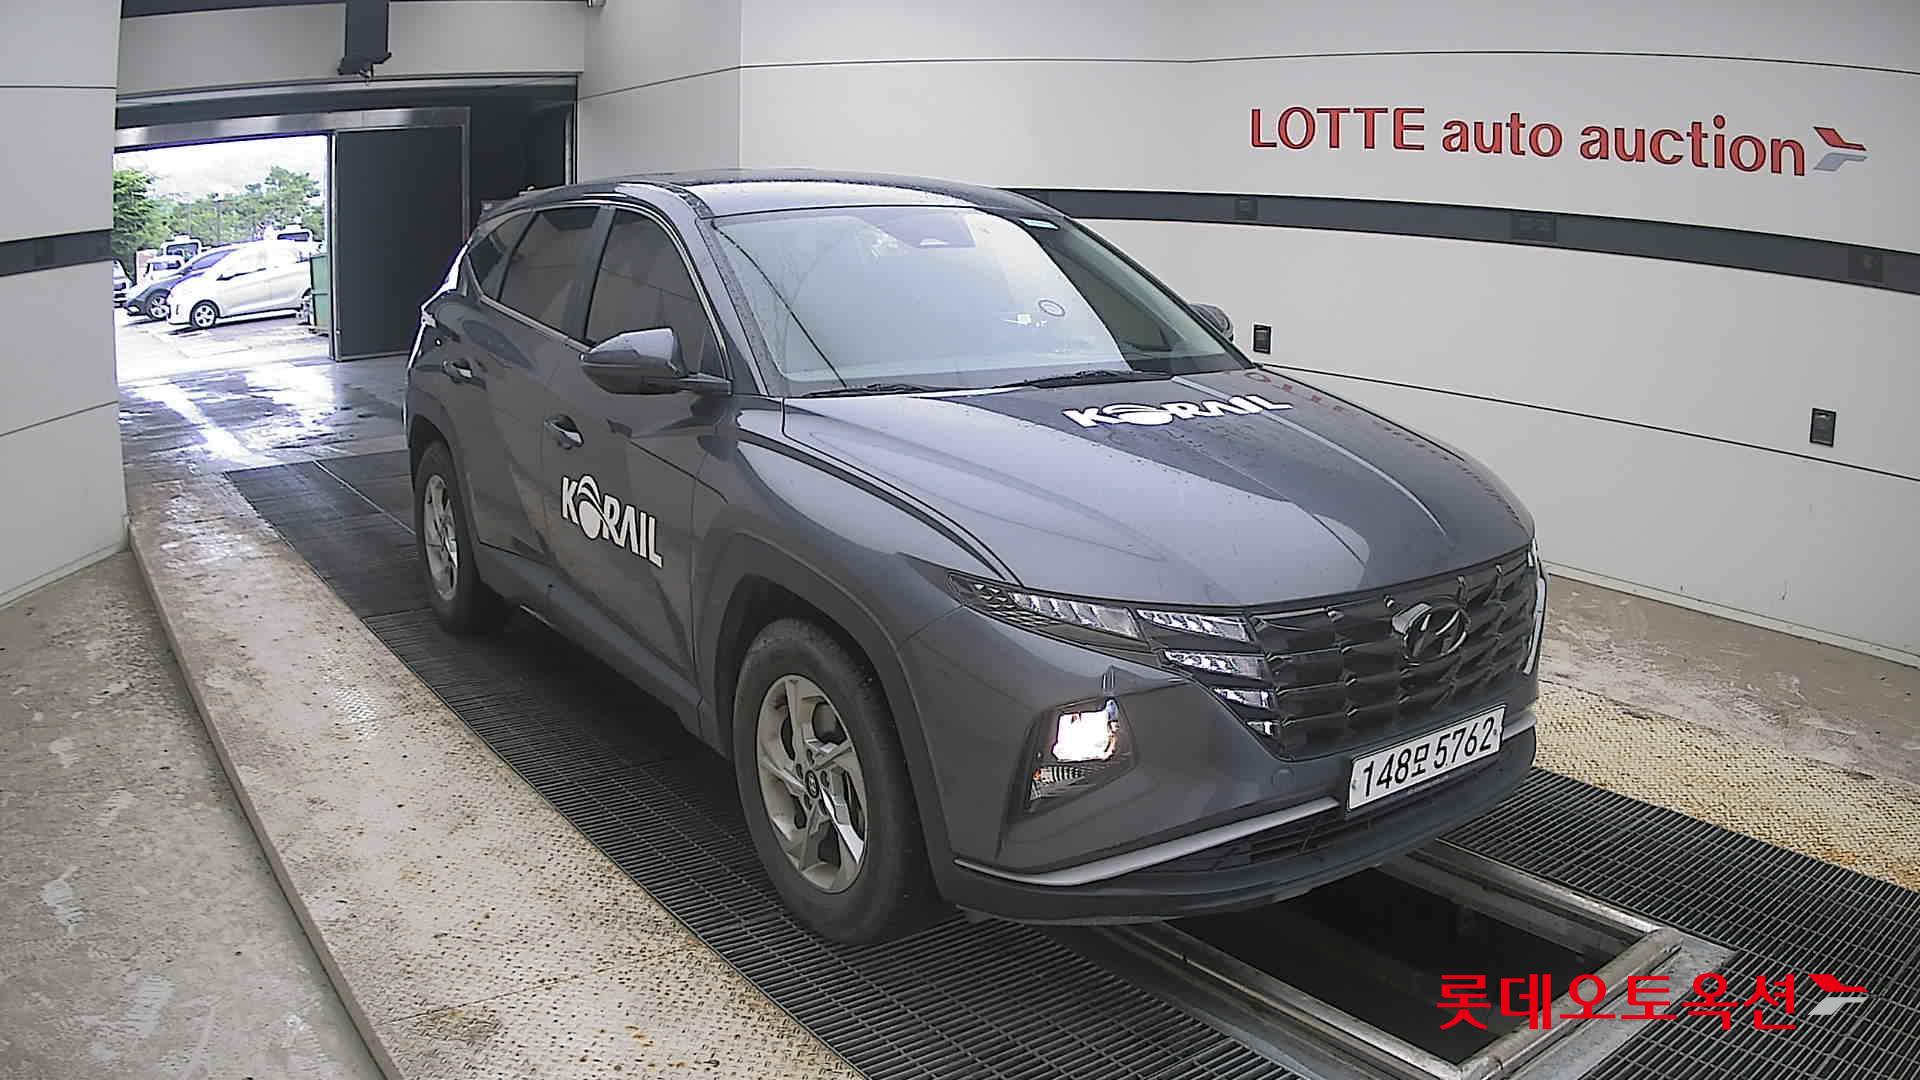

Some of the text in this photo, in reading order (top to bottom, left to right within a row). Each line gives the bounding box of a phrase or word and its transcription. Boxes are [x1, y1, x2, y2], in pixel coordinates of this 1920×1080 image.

[1250, 107, 1806, 176] LOTTE auto auction
[1063, 394, 1294, 428] KORAIL
[562, 475, 662, 568] KORAIL
